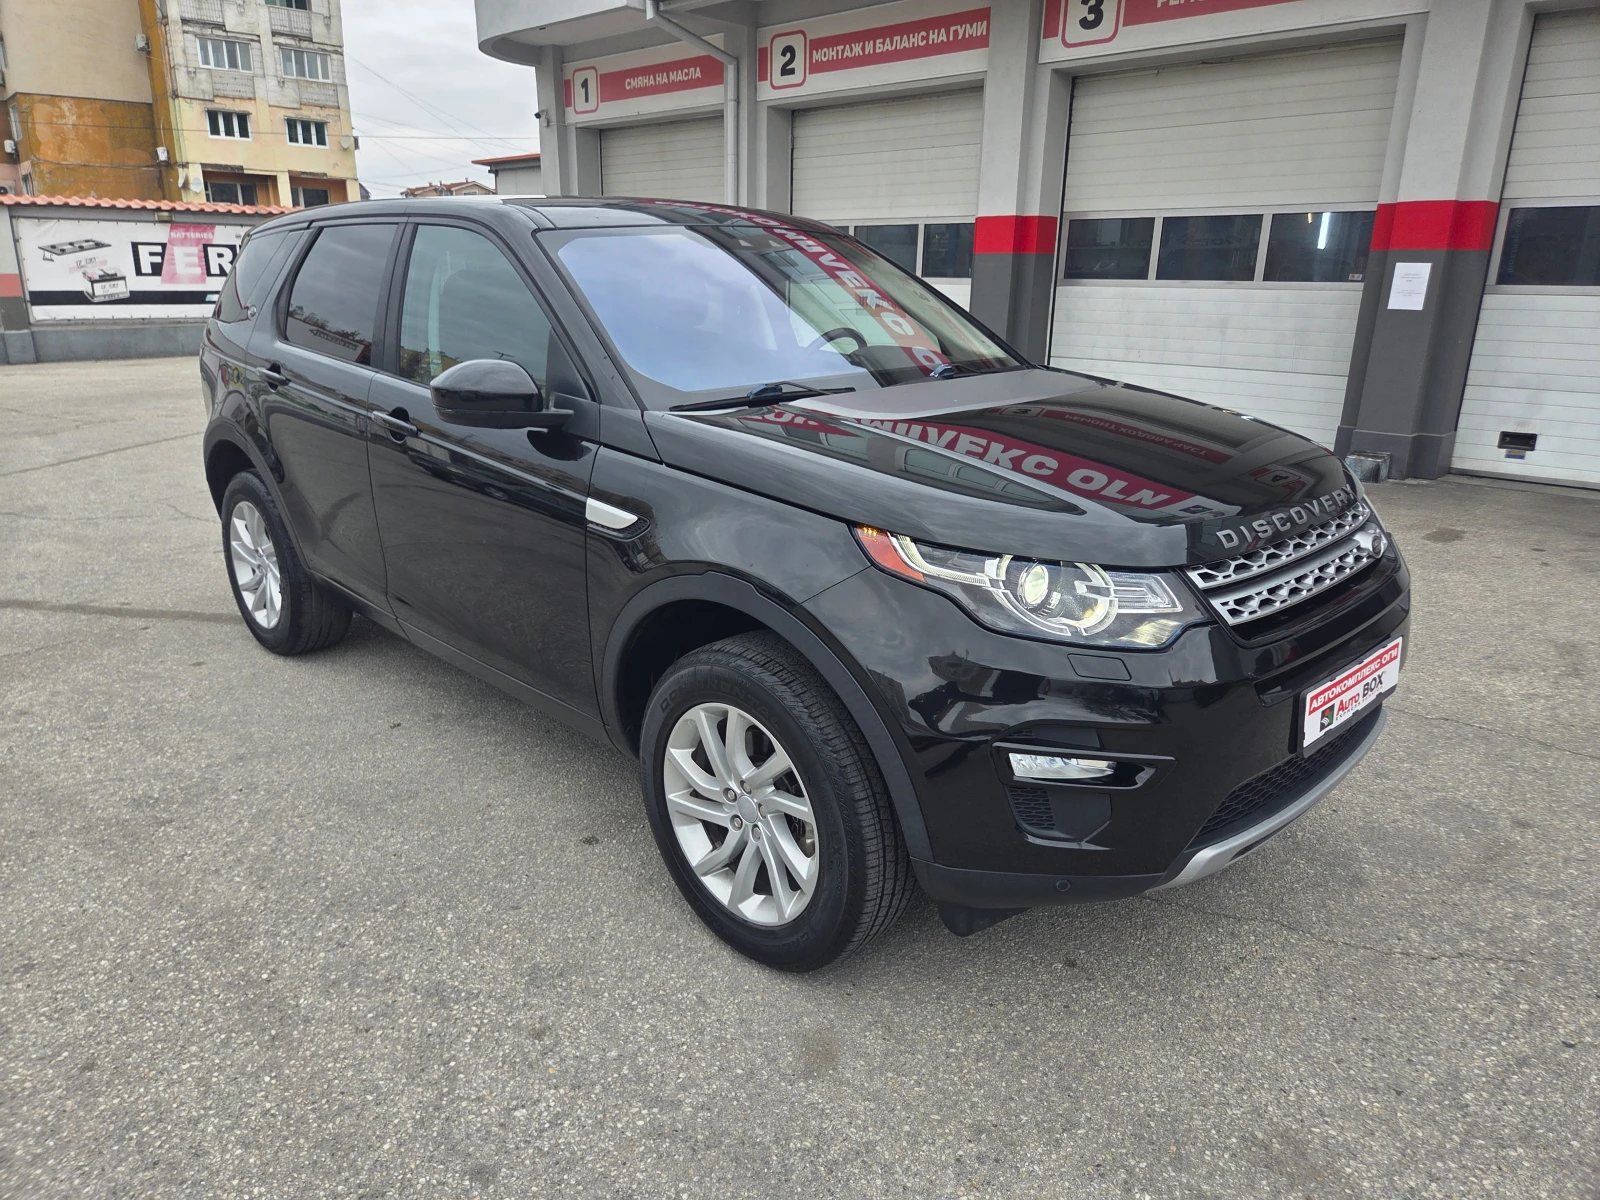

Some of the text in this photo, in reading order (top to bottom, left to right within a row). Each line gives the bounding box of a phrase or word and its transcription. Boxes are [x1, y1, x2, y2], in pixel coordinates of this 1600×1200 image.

[1079, 0, 1104, 30] 3
[812, 20, 987, 63] МОНТАЖ И БАЛАНС НА ГУМИ
[780, 44, 796, 77] 2
[581, 77, 589, 103] 1
[625, 67, 702, 90] СМЯНА НА МАСЛА
[170, 231, 214, 240] BATTERIES
[137, 244, 241, 275] FER
[1215, 483, 1355, 549] DISCOVERY
[1310, 647, 1398, 711] АВТОКОМПЛЕКС ОГИ
[1362, 670, 1385, 698] BOX
